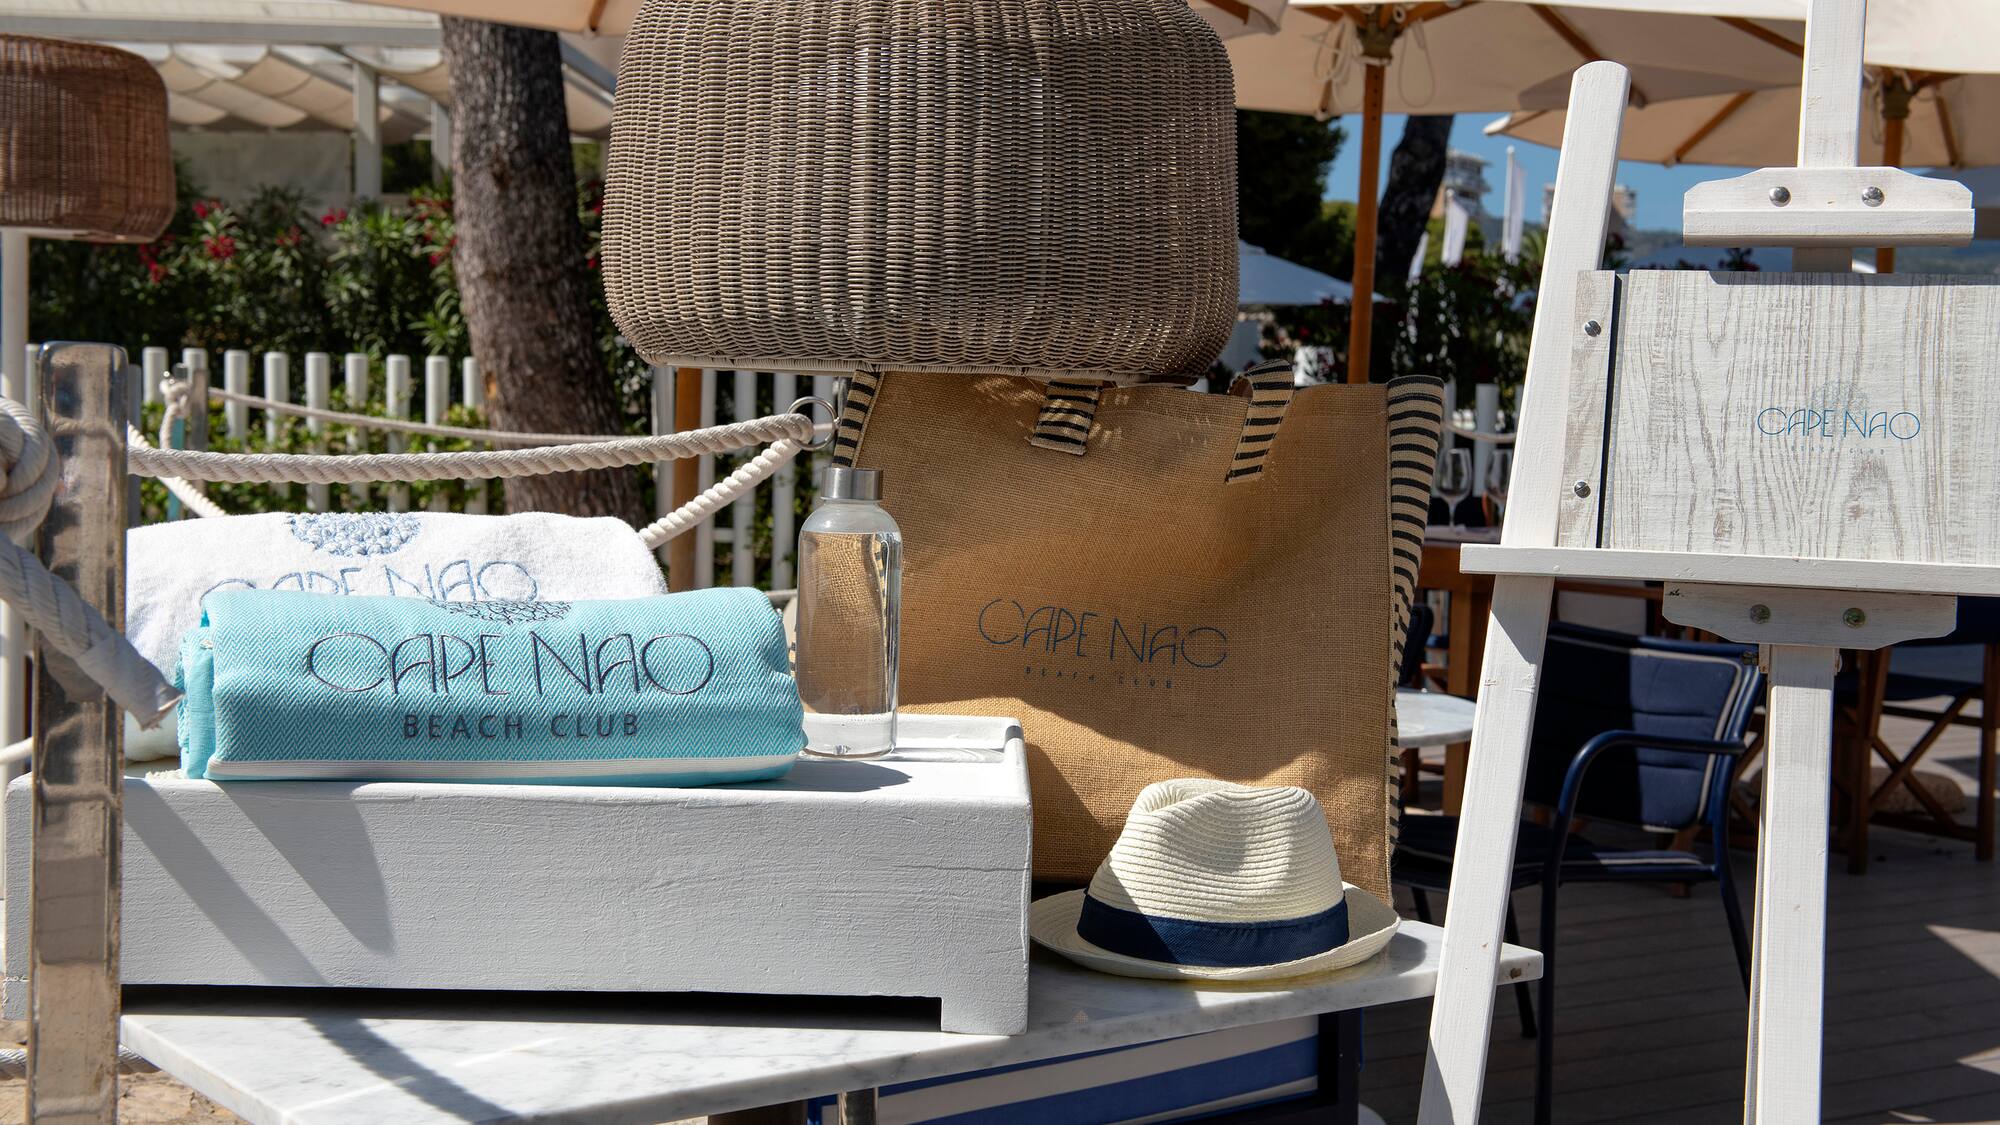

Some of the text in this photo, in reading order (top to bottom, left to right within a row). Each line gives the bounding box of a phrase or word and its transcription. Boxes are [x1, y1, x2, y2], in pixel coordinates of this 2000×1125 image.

[1757, 408, 1921, 440] CAPE NAO
[979, 599, 1098, 656] CAPE
[308, 631, 714, 696] CAPE NAO
[403, 713, 639, 740] BEACH CLUB
